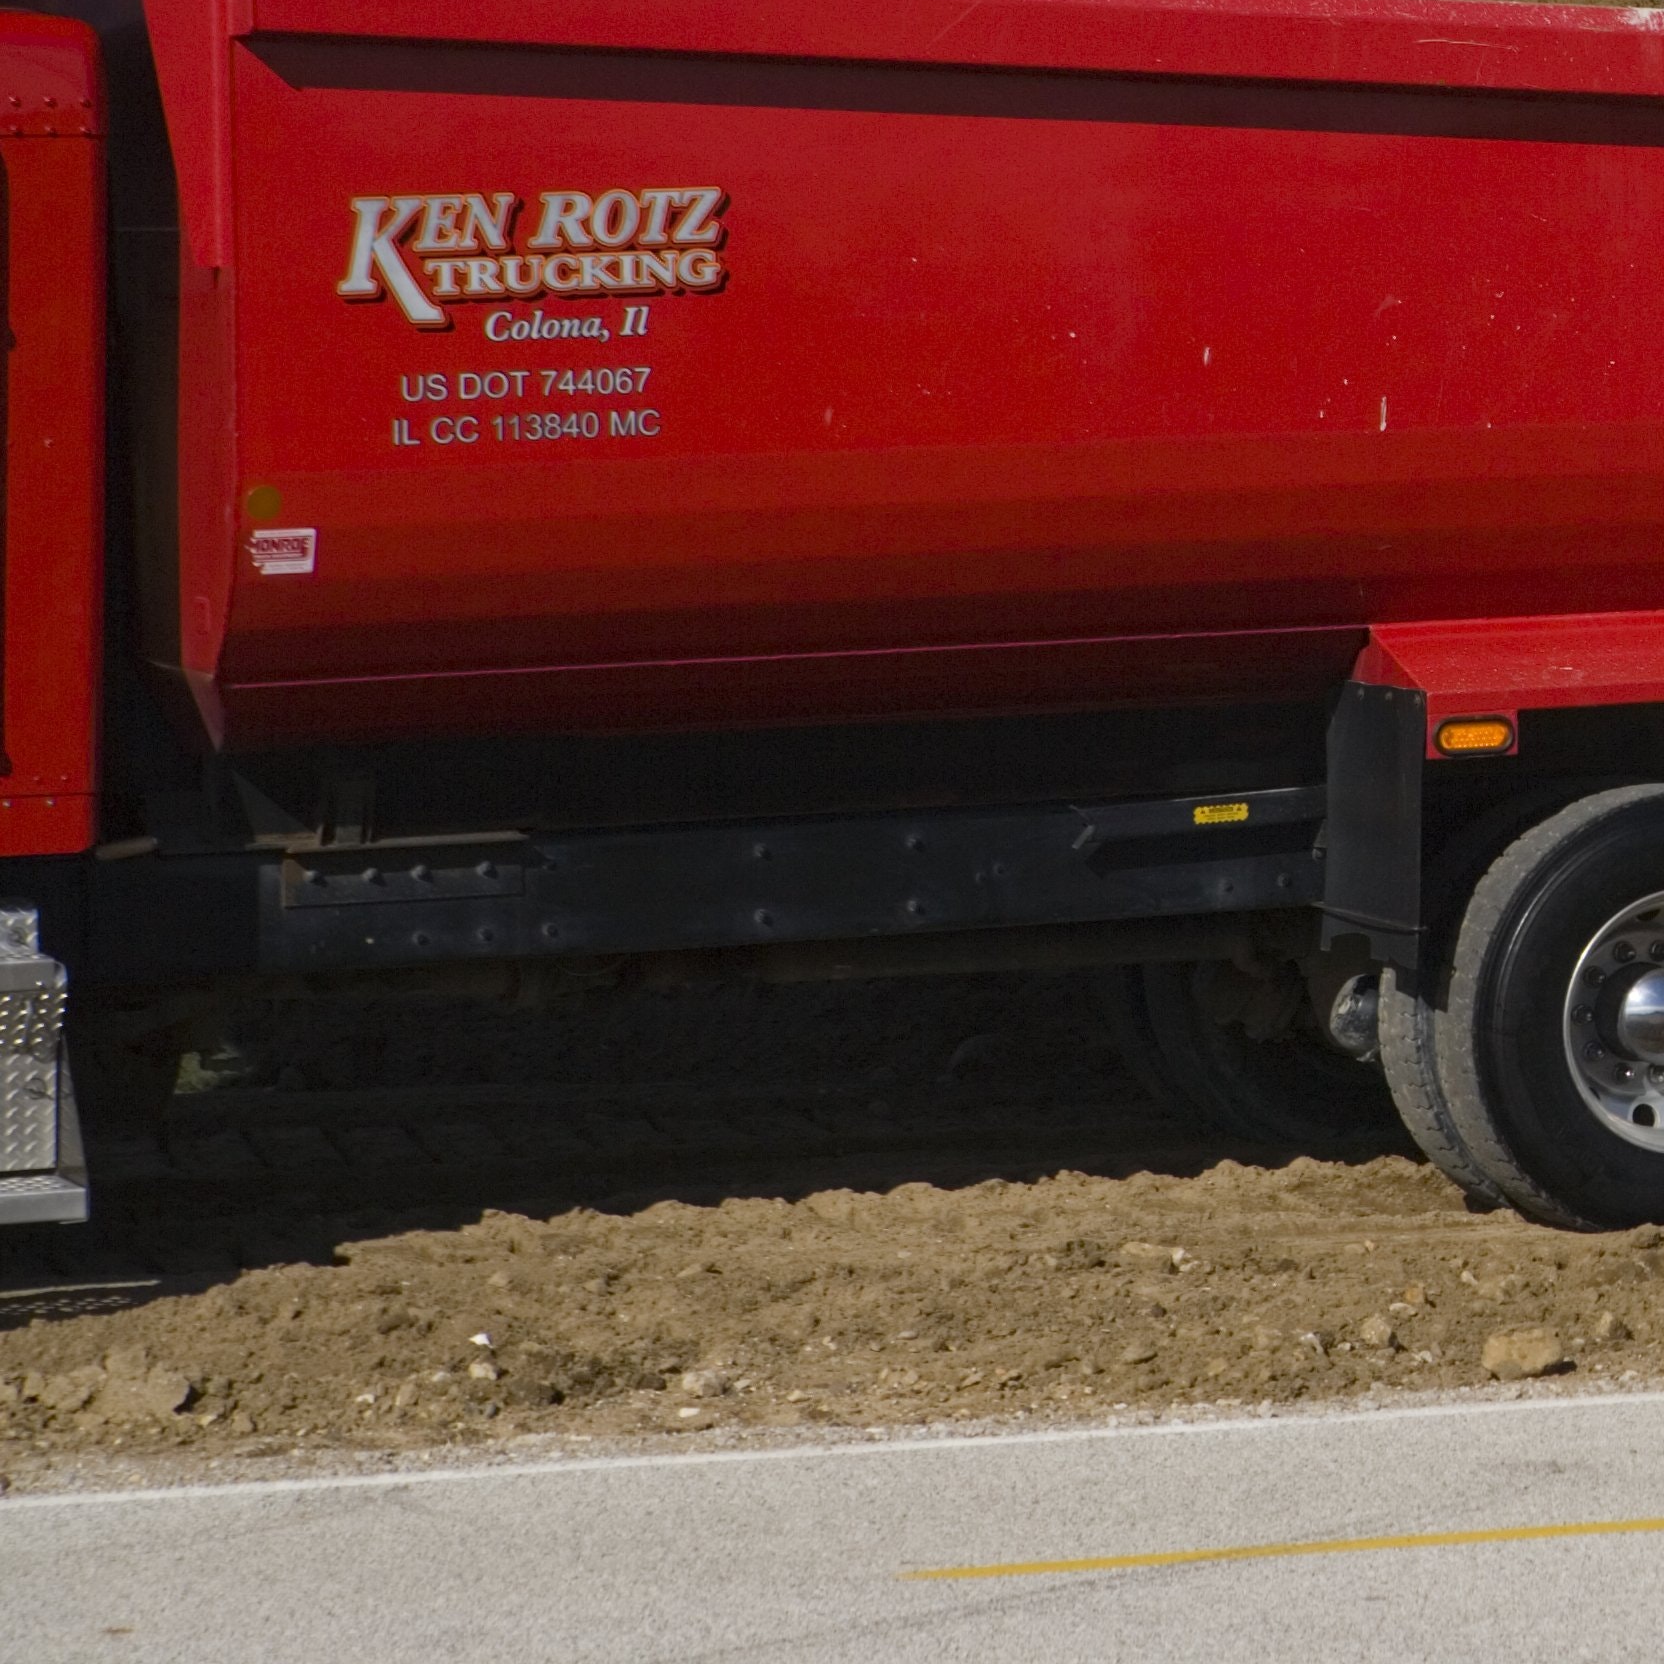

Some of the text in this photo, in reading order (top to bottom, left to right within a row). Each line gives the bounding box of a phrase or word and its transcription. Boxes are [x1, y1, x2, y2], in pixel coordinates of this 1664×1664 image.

[337, 186, 725, 326] KEN ROTZ
[424, 249, 723, 298] TRUCKING
[484, 310, 611, 342] Colona,
[401, 367, 652, 402] US DOT 744067
[392, 409, 661, 446] IL CC 113840 MC
